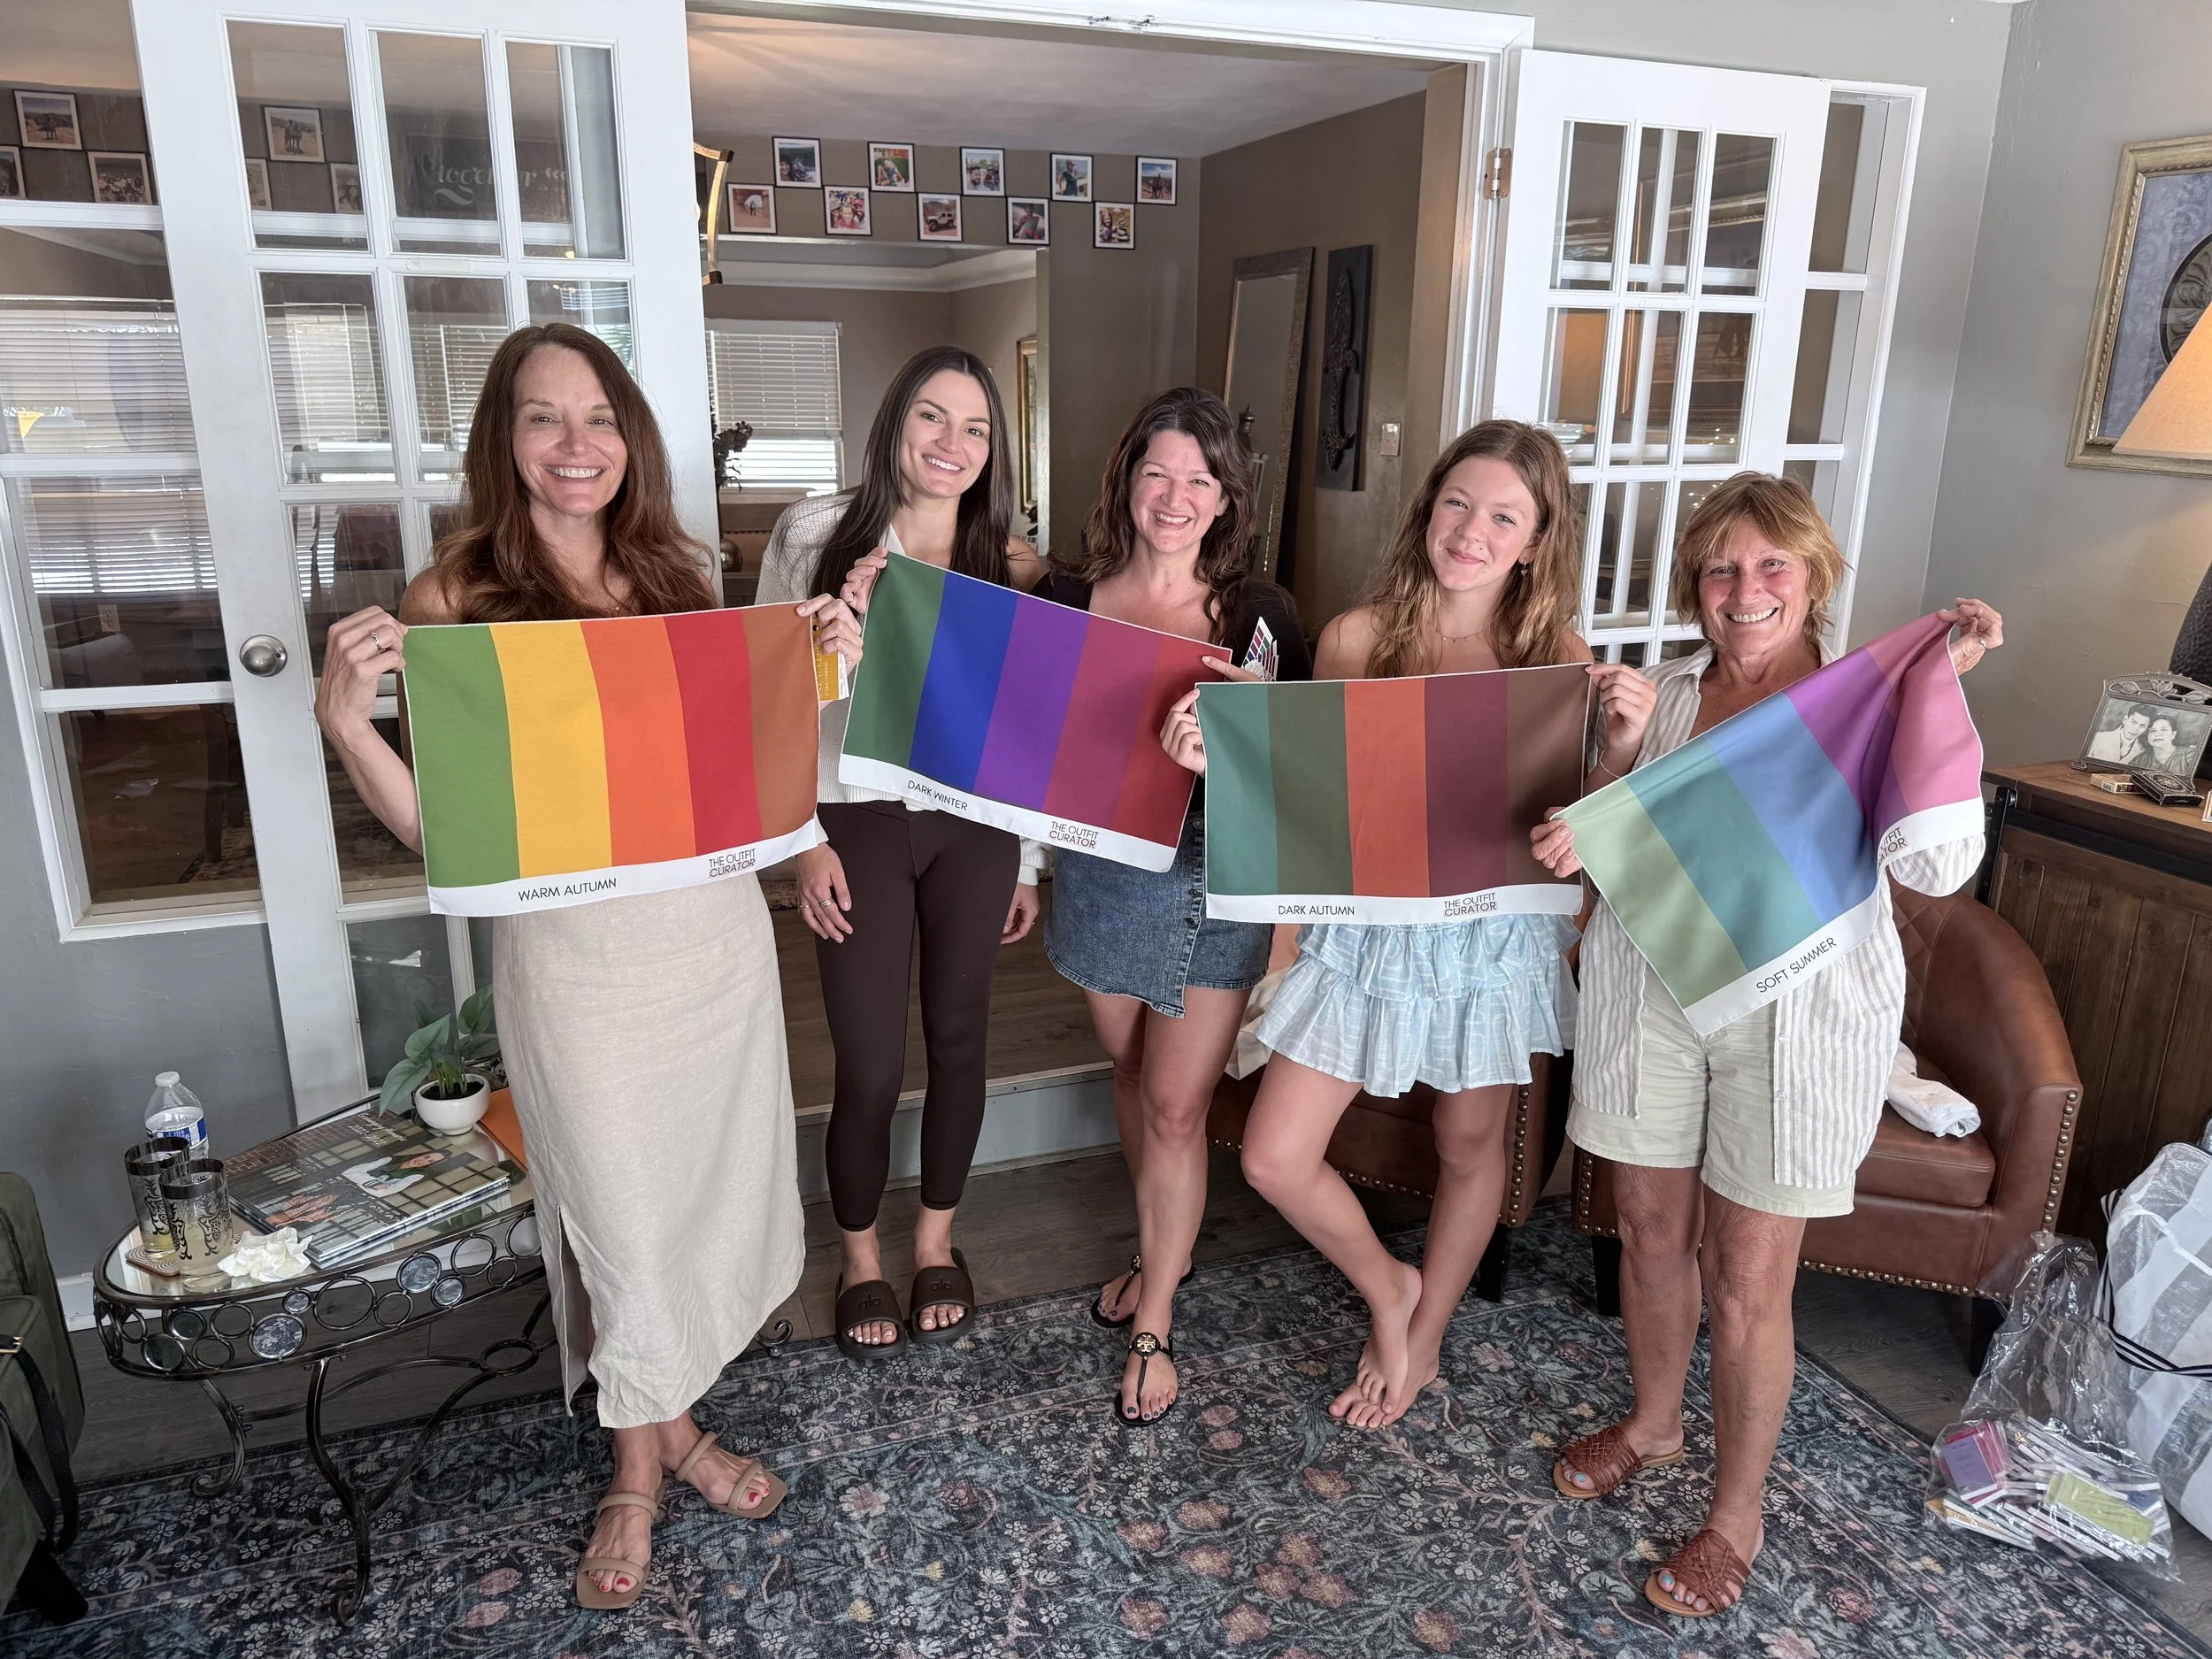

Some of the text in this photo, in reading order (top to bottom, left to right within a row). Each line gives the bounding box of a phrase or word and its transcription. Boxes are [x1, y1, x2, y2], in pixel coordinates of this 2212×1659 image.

[907, 780, 968, 811] DARK WINTER
[1049, 830, 1096, 849] CURATOR
[1051, 820, 1100, 841] THE OUTFIT
[709, 848, 756, 869] THE OUTFIT
[710, 858, 756, 878] CURATOR
[518, 878, 617, 902] WARM AUTUMN
[1278, 905, 1356, 916] DARK AUTUMN
[1443, 892, 1496, 910] THE OUTFIT
[1444, 902, 1496, 917] CURATOR
[1755, 937, 1838, 994] SOFT SUMMER
[930, 1276, 953, 1292] alo
[858, 1293, 882, 1310] alo
